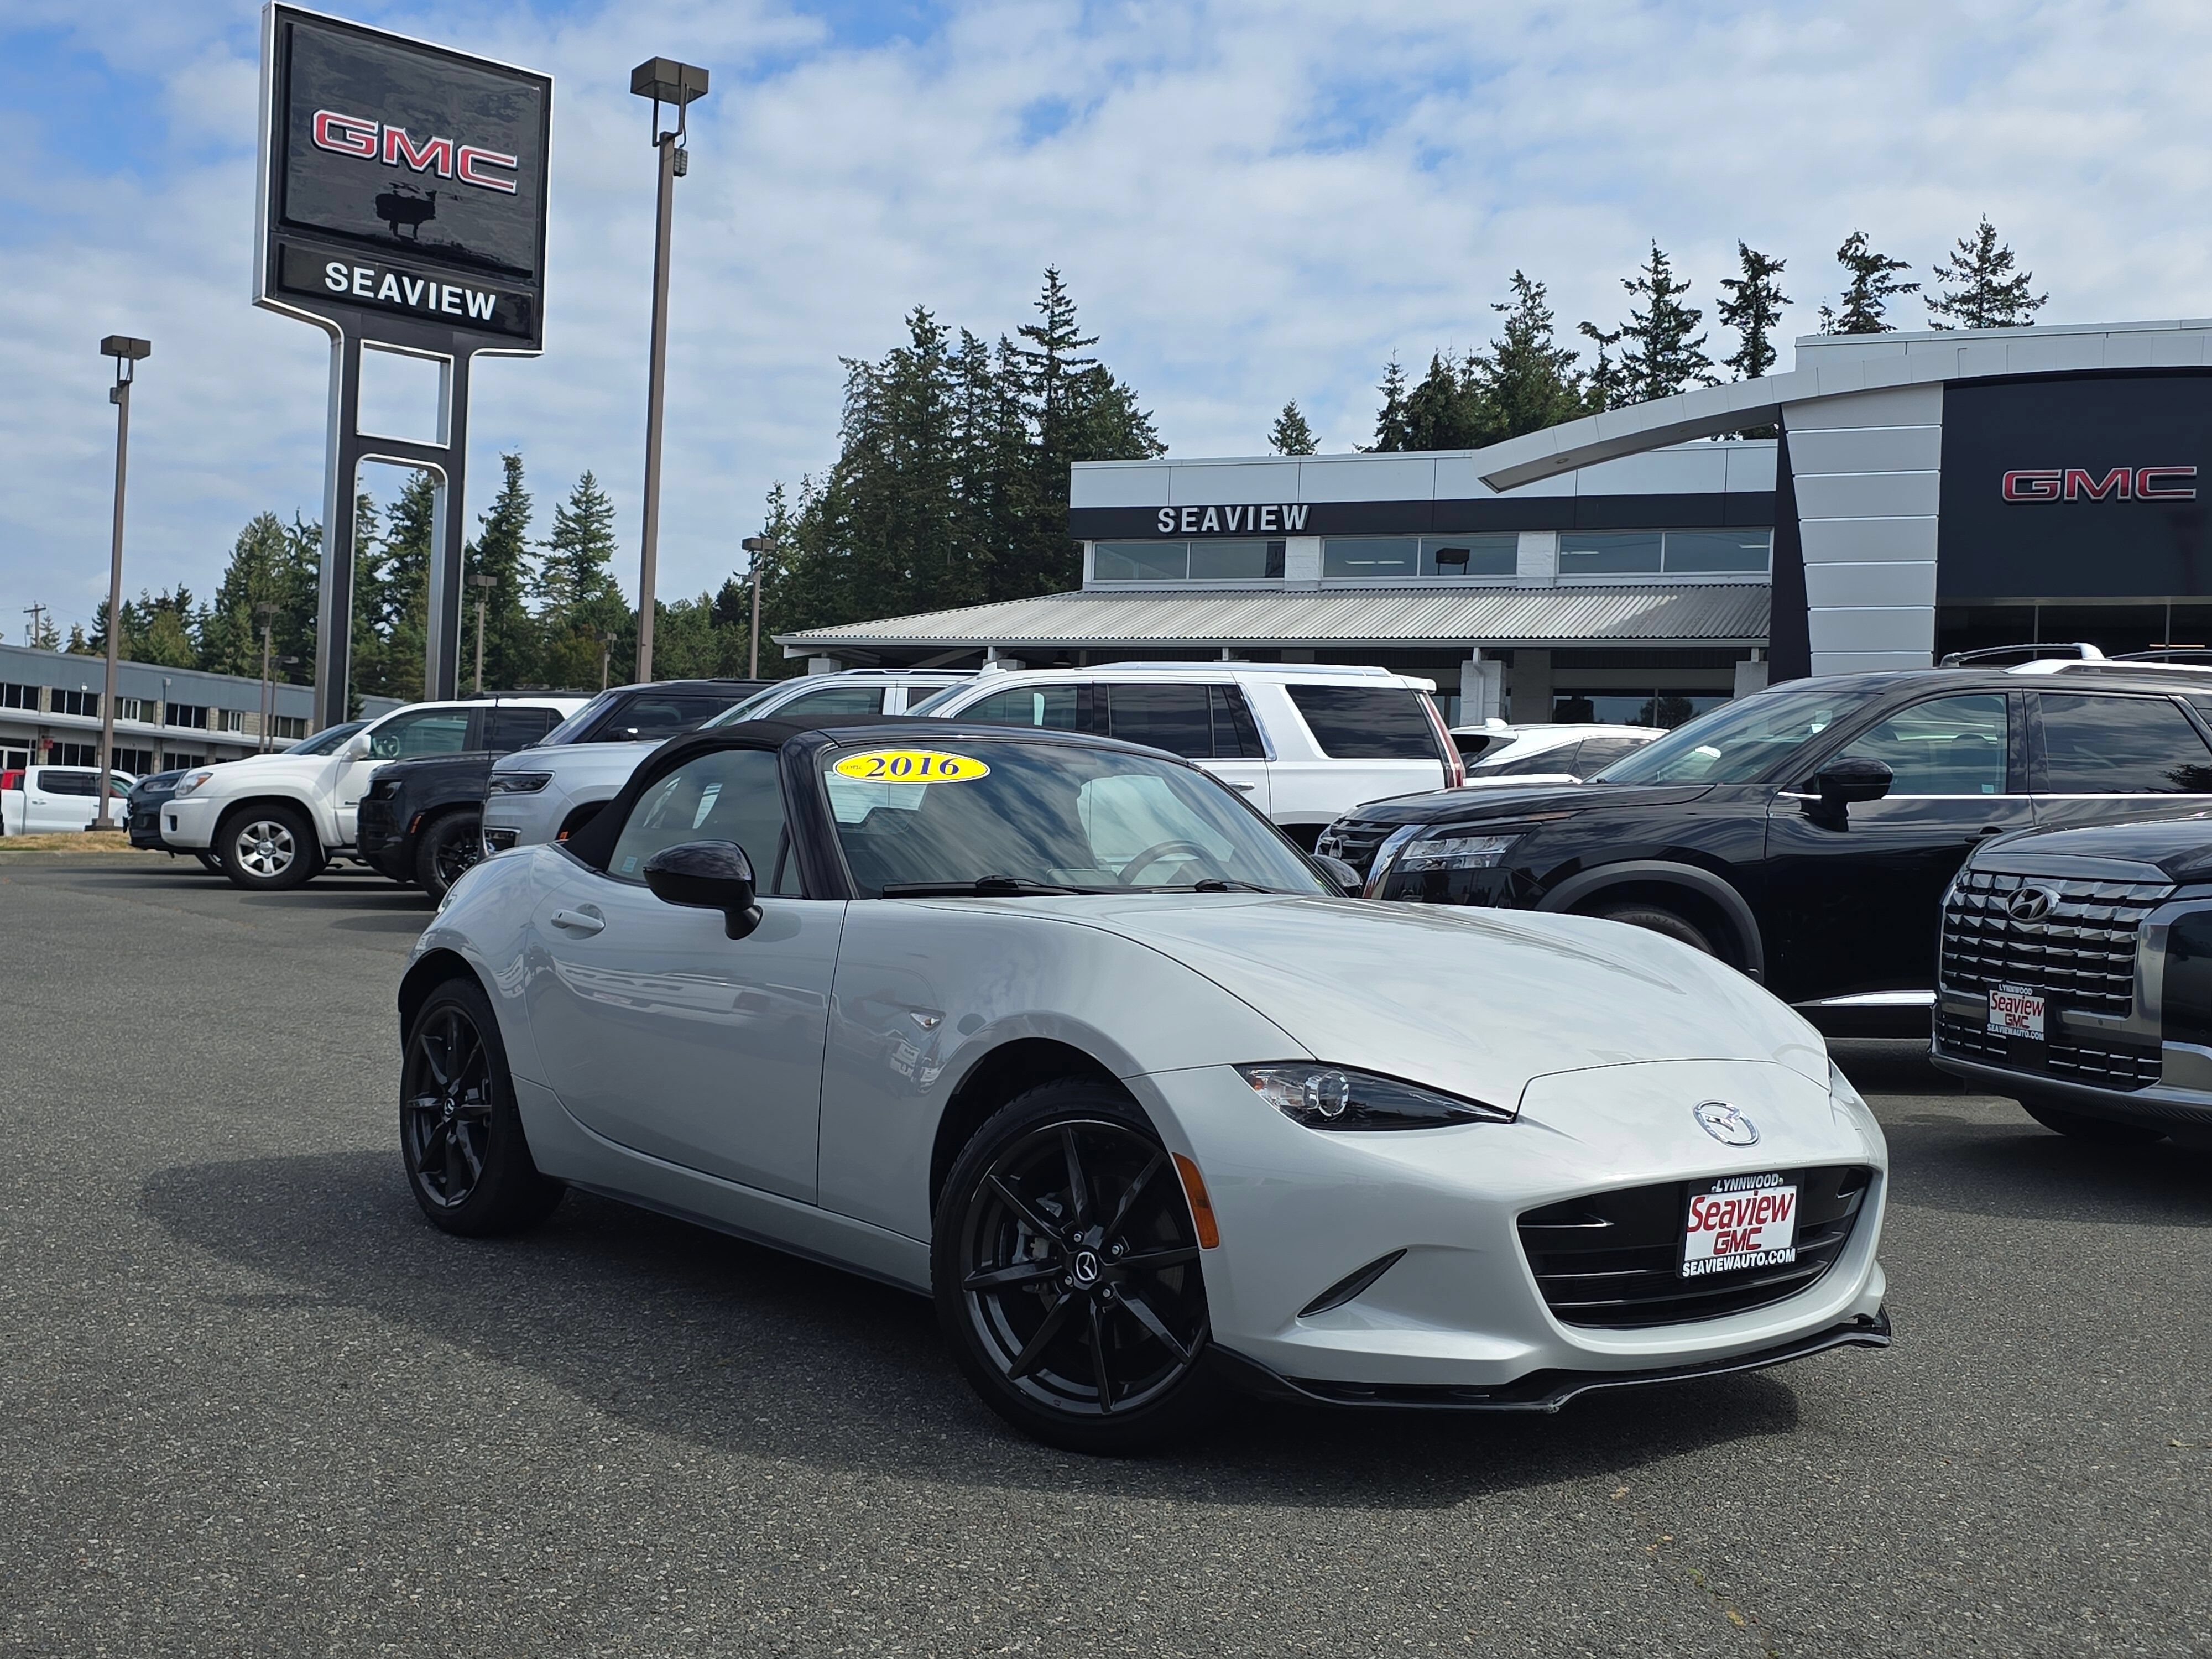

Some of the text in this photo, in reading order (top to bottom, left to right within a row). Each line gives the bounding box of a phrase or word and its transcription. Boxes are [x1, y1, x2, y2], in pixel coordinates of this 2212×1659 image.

[313, 109, 517, 194] GMC
[325, 262, 496, 320] SEAVIEW
[2002, 466, 2198, 501] GMC
[1157, 504, 1309, 533] SEAVIEW
[865, 757, 960, 777] 2016
[1991, 992, 2044, 1017] Seaview
[2005, 1013, 2030, 1029] GMC
[1715, 1173, 1780, 1193] LYNNWOOD
[1687, 1190, 1795, 1233] Seaview
[1713, 1227, 1762, 1255] GMC
[1682, 1248, 1796, 1277] SEAVIEWAUTO.COM
